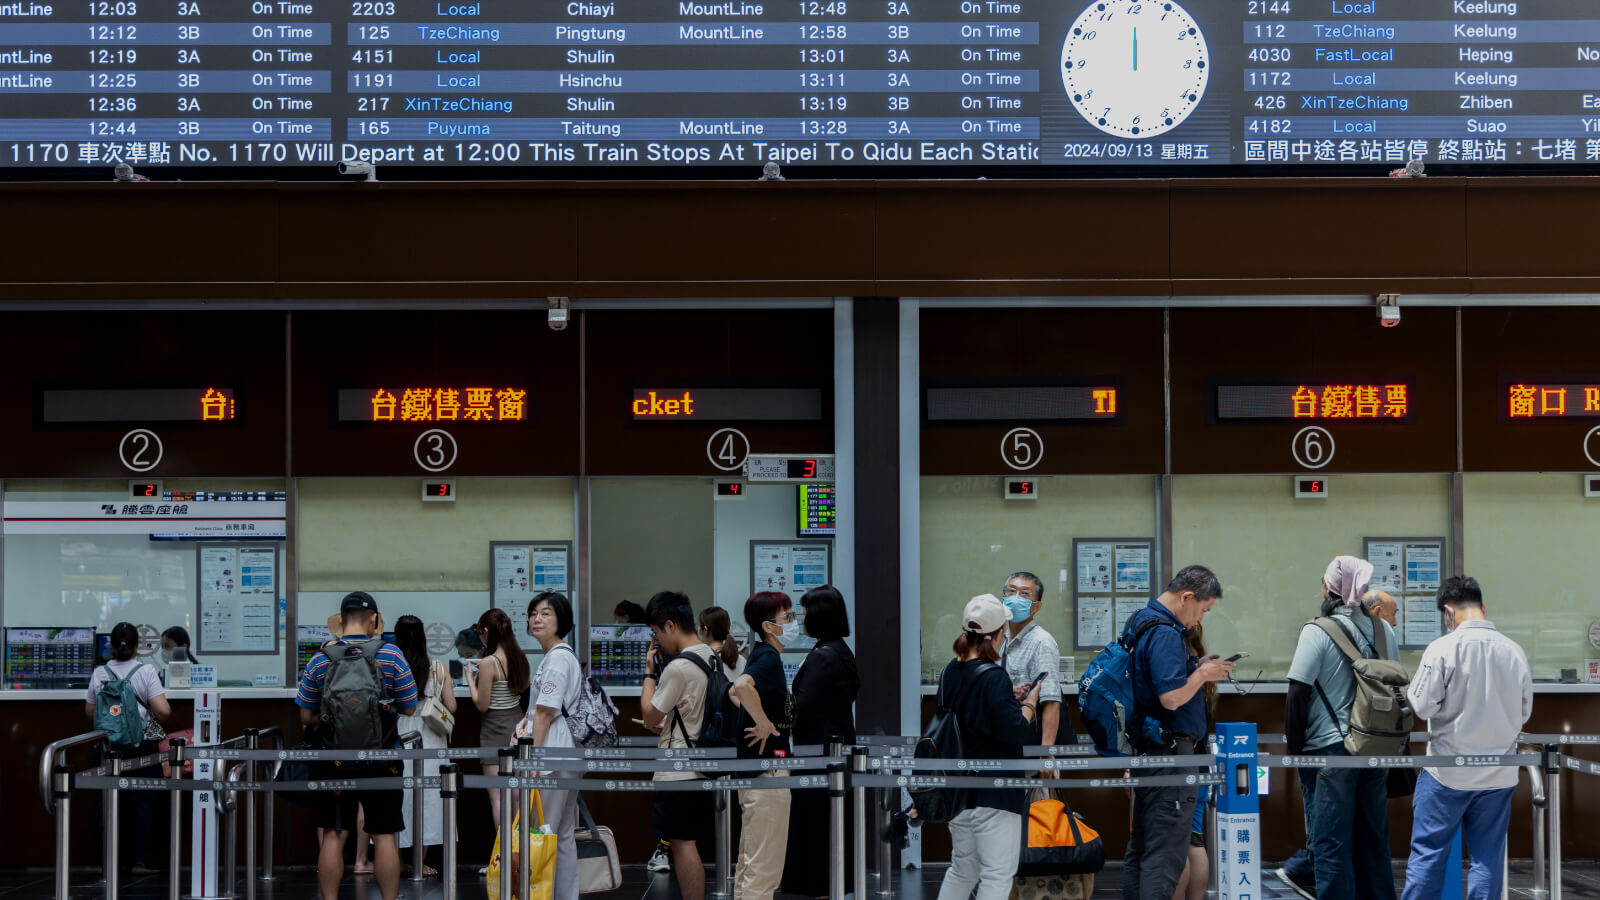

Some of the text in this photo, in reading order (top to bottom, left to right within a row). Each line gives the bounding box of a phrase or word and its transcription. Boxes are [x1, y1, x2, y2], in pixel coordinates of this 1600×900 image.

[0, 0, 311, 16] ntLine 12:03 3A On Time
[353, 0, 1020, 18] 2203 Local Chiayi MountLine 12:48 3A On Time
[1127, 4, 1141, 15] 12
[1249, 0, 1516, 16] 2144 Local Keelung
[1100, 12, 1114, 21] 11
[1161, 12, 1167, 21] 1
[90, 24, 312, 40] 12:12 3B On Time
[360, 24, 1020, 41] 125 TzeChiang Pingtung MountLine 12:58 3B On Time
[1082, 30, 1096, 41] 10
[1177, 30, 1186, 41] 2
[1256, 24, 1518, 40] 112 TzeChiang Keelung
[0, 49, 312, 64] ntLine 12:19 3A On Time
[352, 48, 1020, 64] 4151 Local Shulin 13:01 3A On Time
[1249, 48, 1290, 64] 4030
[1315, 48, 1393, 64] FastLocal
[1459, 48, 1512, 64] Heping
[1077, 59, 1086, 70] 9
[1183, 59, 1192, 70] 3
[0, 72, 312, 88] ntLine 12:25 3B On Time
[354, 72, 1020, 88] 1191 Local Hsinchu 13:11 3A On Time
[1251, 71, 1518, 88] 1172 Local Keelung
[1084, 89, 1093, 100] 8
[1179, 88, 1190, 100] 4
[90, 96, 312, 112] 12:36 3A On Time
[358, 96, 1020, 113] 217 XinTzeChiang Shulin 13:19 3B On Time
[1255, 95, 1512, 112] 426 XinTzeChiang Zhiben
[1103, 107, 1111, 117] 7
[1132, 114, 1141, 125] 6
[1160, 108, 1170, 118] 5
[88, 120, 312, 136] 12:44 3B On Time
[360, 120, 1021, 137] 165 Puyuma Taitung MountLine 13:28 3A On Time
[1248, 119, 1506, 136] 4182 Local Suao
[12, 141, 972, 165] 1170 車次準點 No. 1170 Will Depart at 12:00 This Train Stops At Taipei To Qidu Each
[1063, 143, 1209, 160] 2024/09/13 星期五
[1244, 139, 1429, 162] 區間中途各站皆停
[371, 387, 527, 421] 台鐵售票窗
[633, 391, 694, 415] cket
[1292, 385, 1407, 418] 台鐵售票
[1509, 384, 1567, 417] 窗口
[132, 433, 150, 466] 2
[426, 434, 445, 466] 3
[718, 433, 737, 465] 4
[1013, 433, 1031, 465] 5
[1305, 431, 1322, 463] 6
[802, 460, 816, 478] 3
[145, 485, 154, 496] 2
[439, 484, 447, 496] 3
[730, 483, 738, 494] 4
[1021, 482, 1029, 494] 5
[1311, 481, 1319, 493] 6
